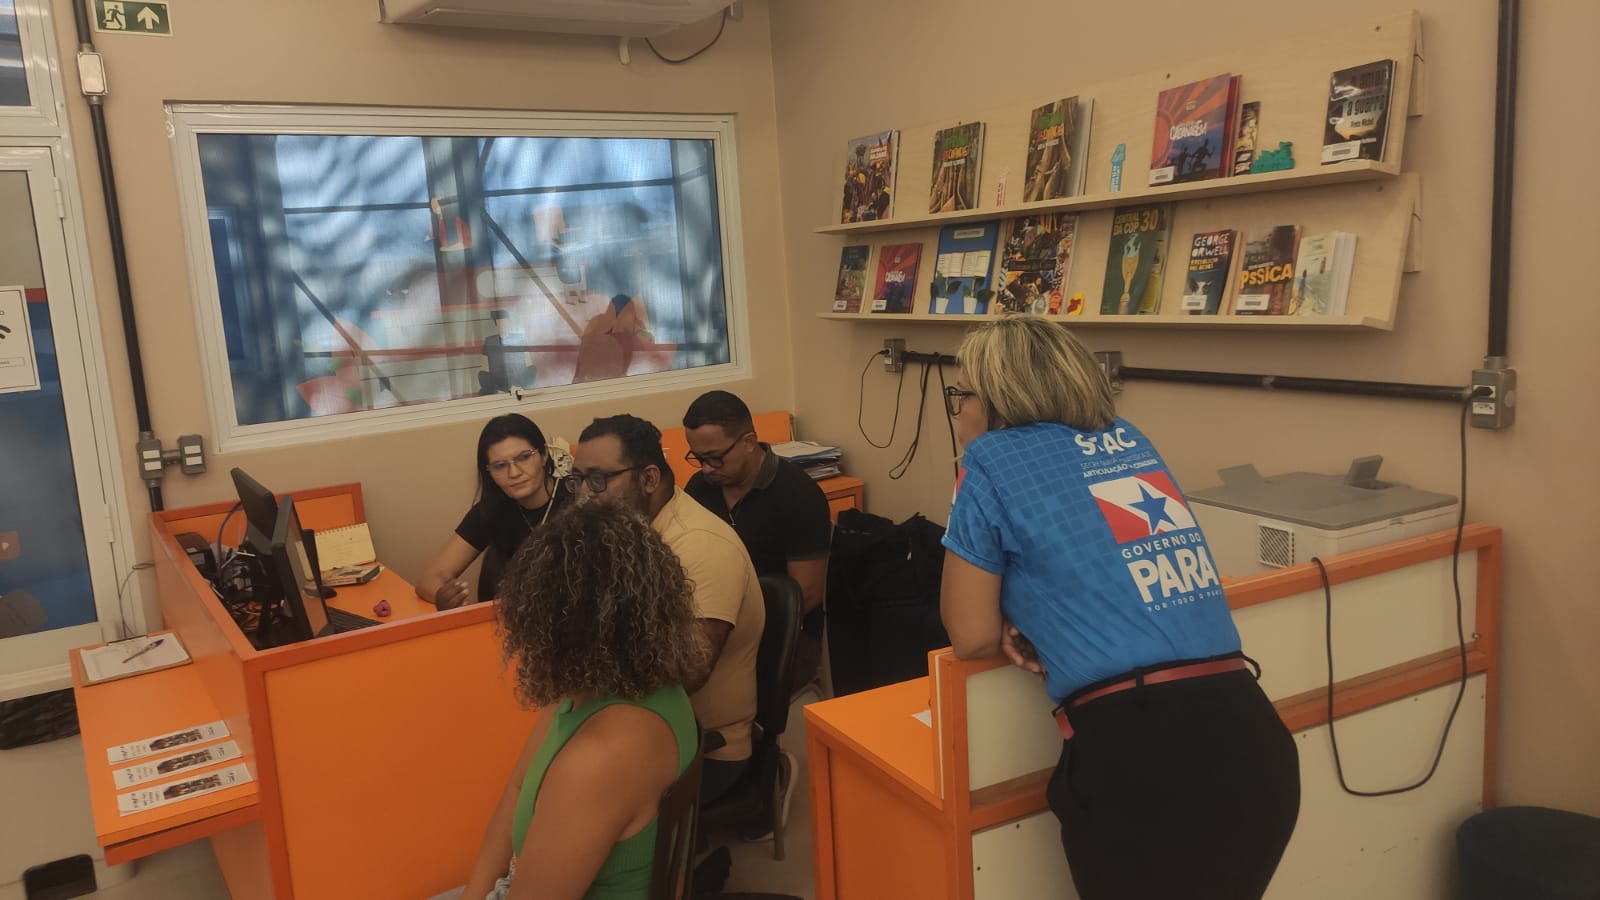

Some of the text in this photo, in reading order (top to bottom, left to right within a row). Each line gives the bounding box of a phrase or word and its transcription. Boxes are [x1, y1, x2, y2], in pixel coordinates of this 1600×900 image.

[1123, 222, 1140, 234] COP
[1140, 208, 1159, 232] 30
[1194, 232, 1230, 247] GEORGE
[1191, 244, 1229, 257] ORWELL
[1121, 532, 1201, 559] GOVERNO DO
[1147, 602, 1168, 613] POR
[1172, 595, 1195, 606] TODO
